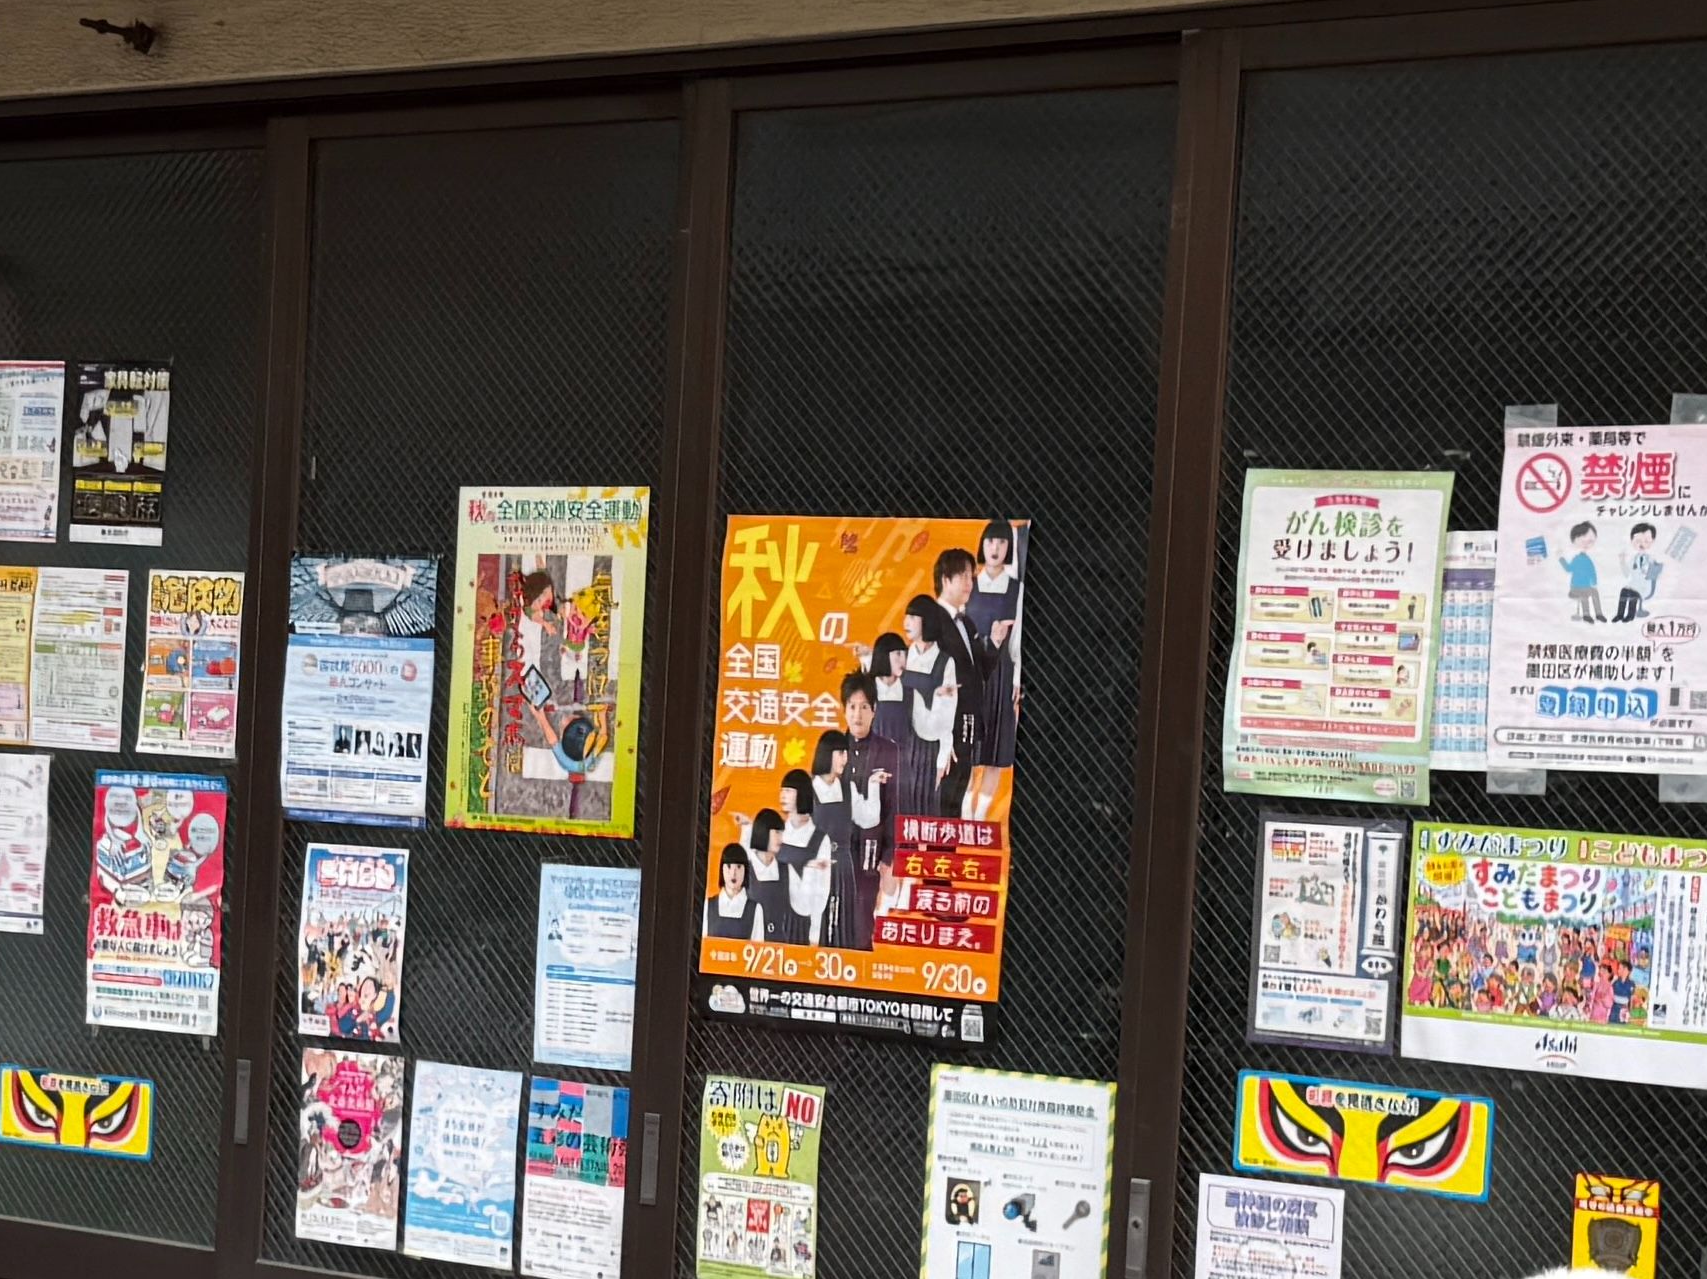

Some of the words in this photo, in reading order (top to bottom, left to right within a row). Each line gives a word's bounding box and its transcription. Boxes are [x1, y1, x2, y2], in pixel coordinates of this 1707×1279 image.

[1285, 510, 1404, 538] がん検診を
[726, 523, 849, 646] 秋の
[723, 642, 782, 682] 全国
[720, 686, 843, 730] 交通安全
[718, 731, 779, 771] 運動
[902, 818, 994, 846] 横断歩道は
[905, 853, 987, 881] 右、左、右。
[1471, 857, 1603, 890] すみだまつり
[915, 888, 991, 915] 渡る前の
[1481, 887, 1599, 915] こどもまつり
[880, 920, 981, 950] あたりまえ。
[786, 1091, 816, 1124] NO
